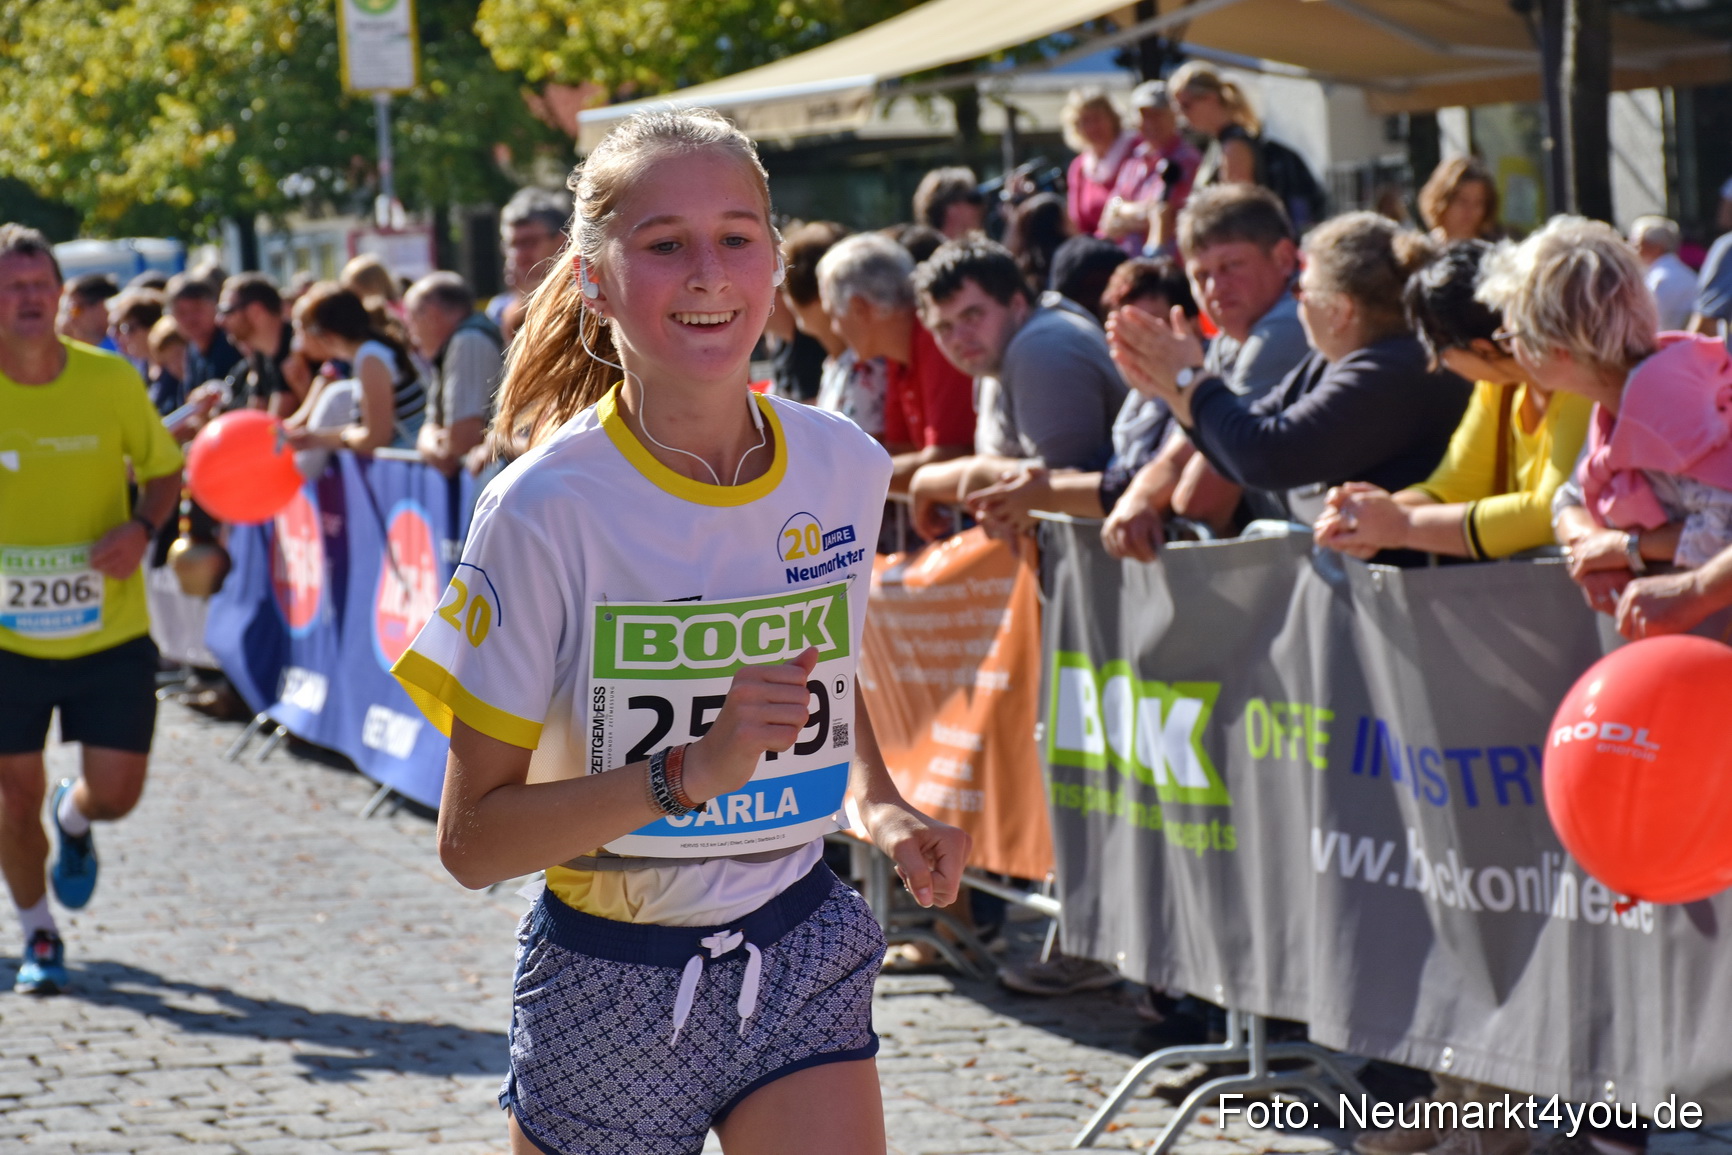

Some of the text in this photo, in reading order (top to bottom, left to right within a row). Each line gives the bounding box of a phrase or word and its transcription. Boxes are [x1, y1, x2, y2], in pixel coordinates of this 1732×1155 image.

[783, 523, 851, 561] 20 JAHRE
[786, 548, 865, 584] Neumarkter
[8, 576, 90, 607] 2206
[438, 576, 492, 648] 20
[616, 596, 836, 670] BOCK
[836, 680, 844, 694] D
[625, 679, 830, 766] 259
[665, 787, 800, 828] CARLA
